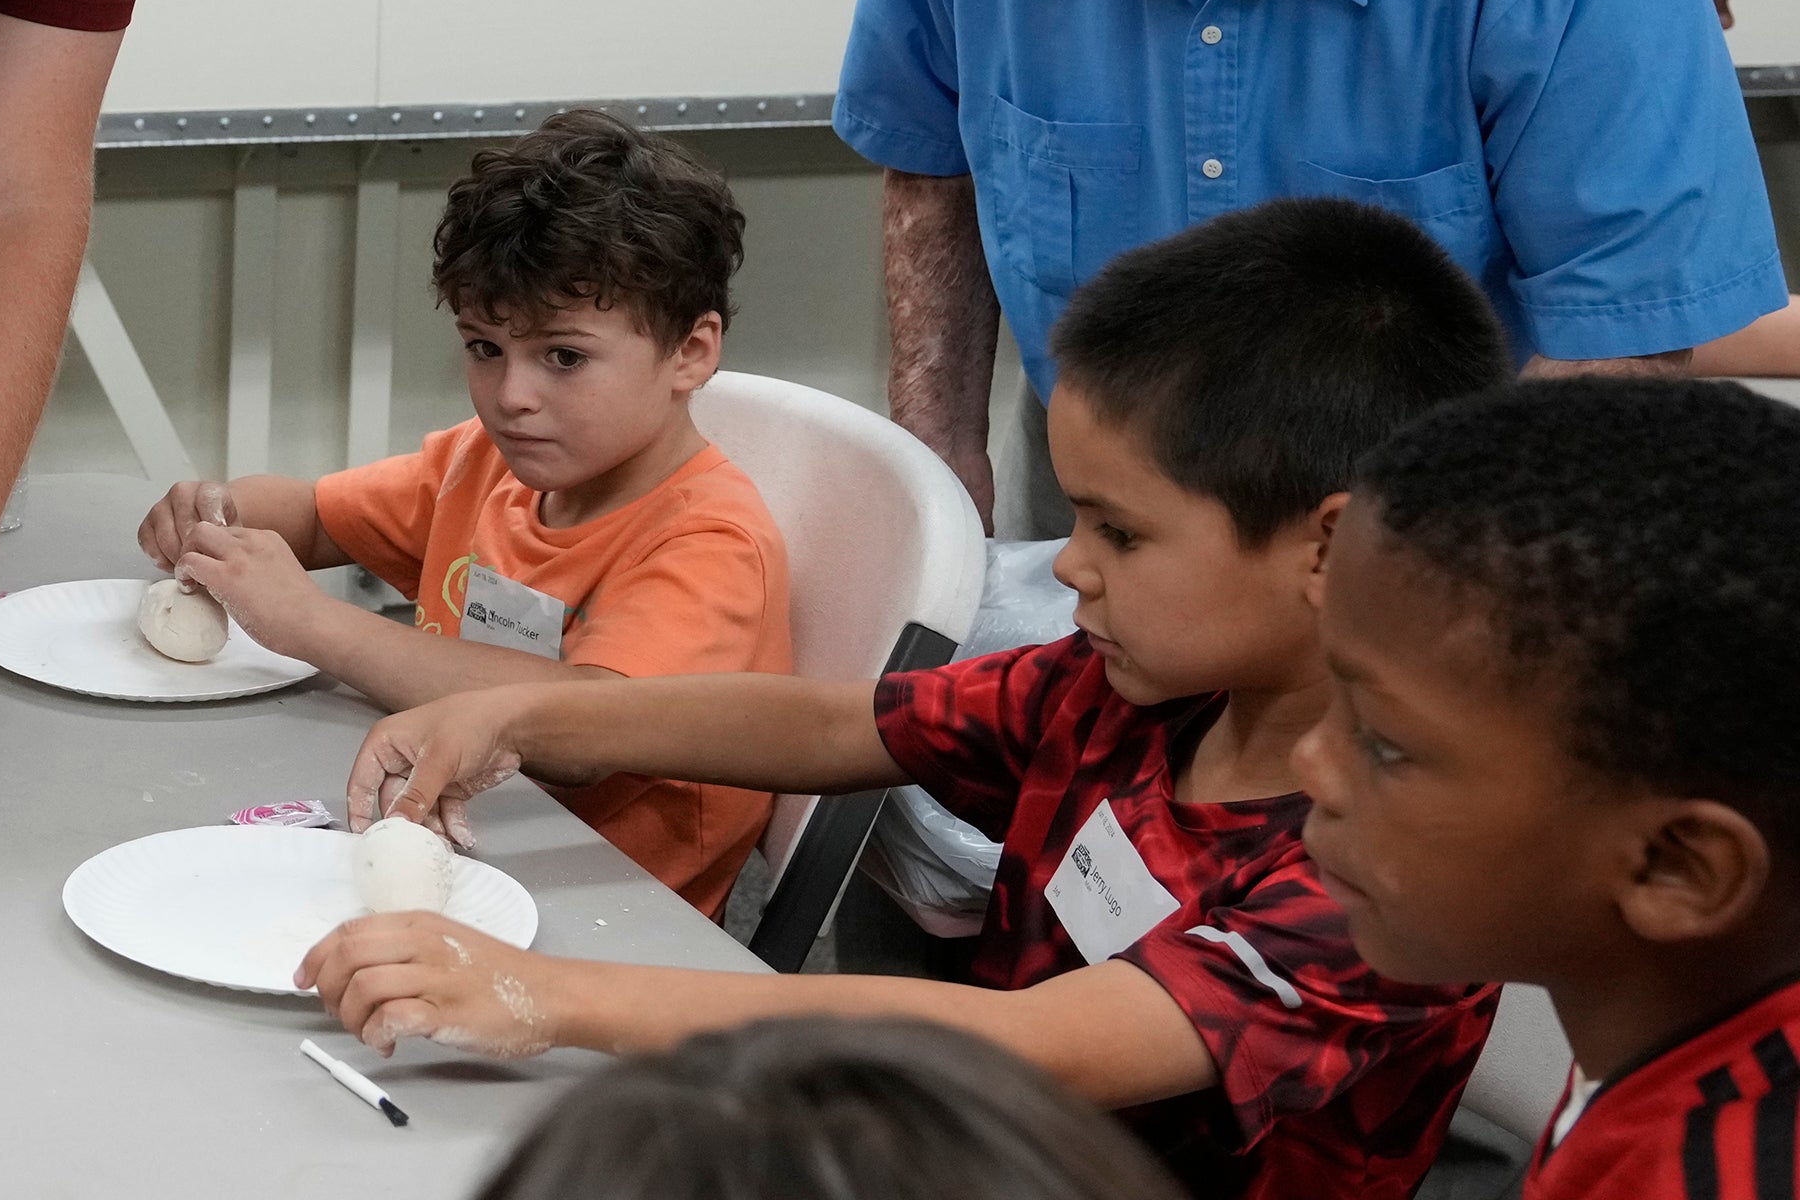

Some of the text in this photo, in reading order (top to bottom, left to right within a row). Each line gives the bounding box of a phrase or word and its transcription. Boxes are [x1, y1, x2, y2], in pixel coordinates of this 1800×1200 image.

[515, 621, 540, 640] Tucker
[1090, 865, 1122, 917] Jerry Lugo
